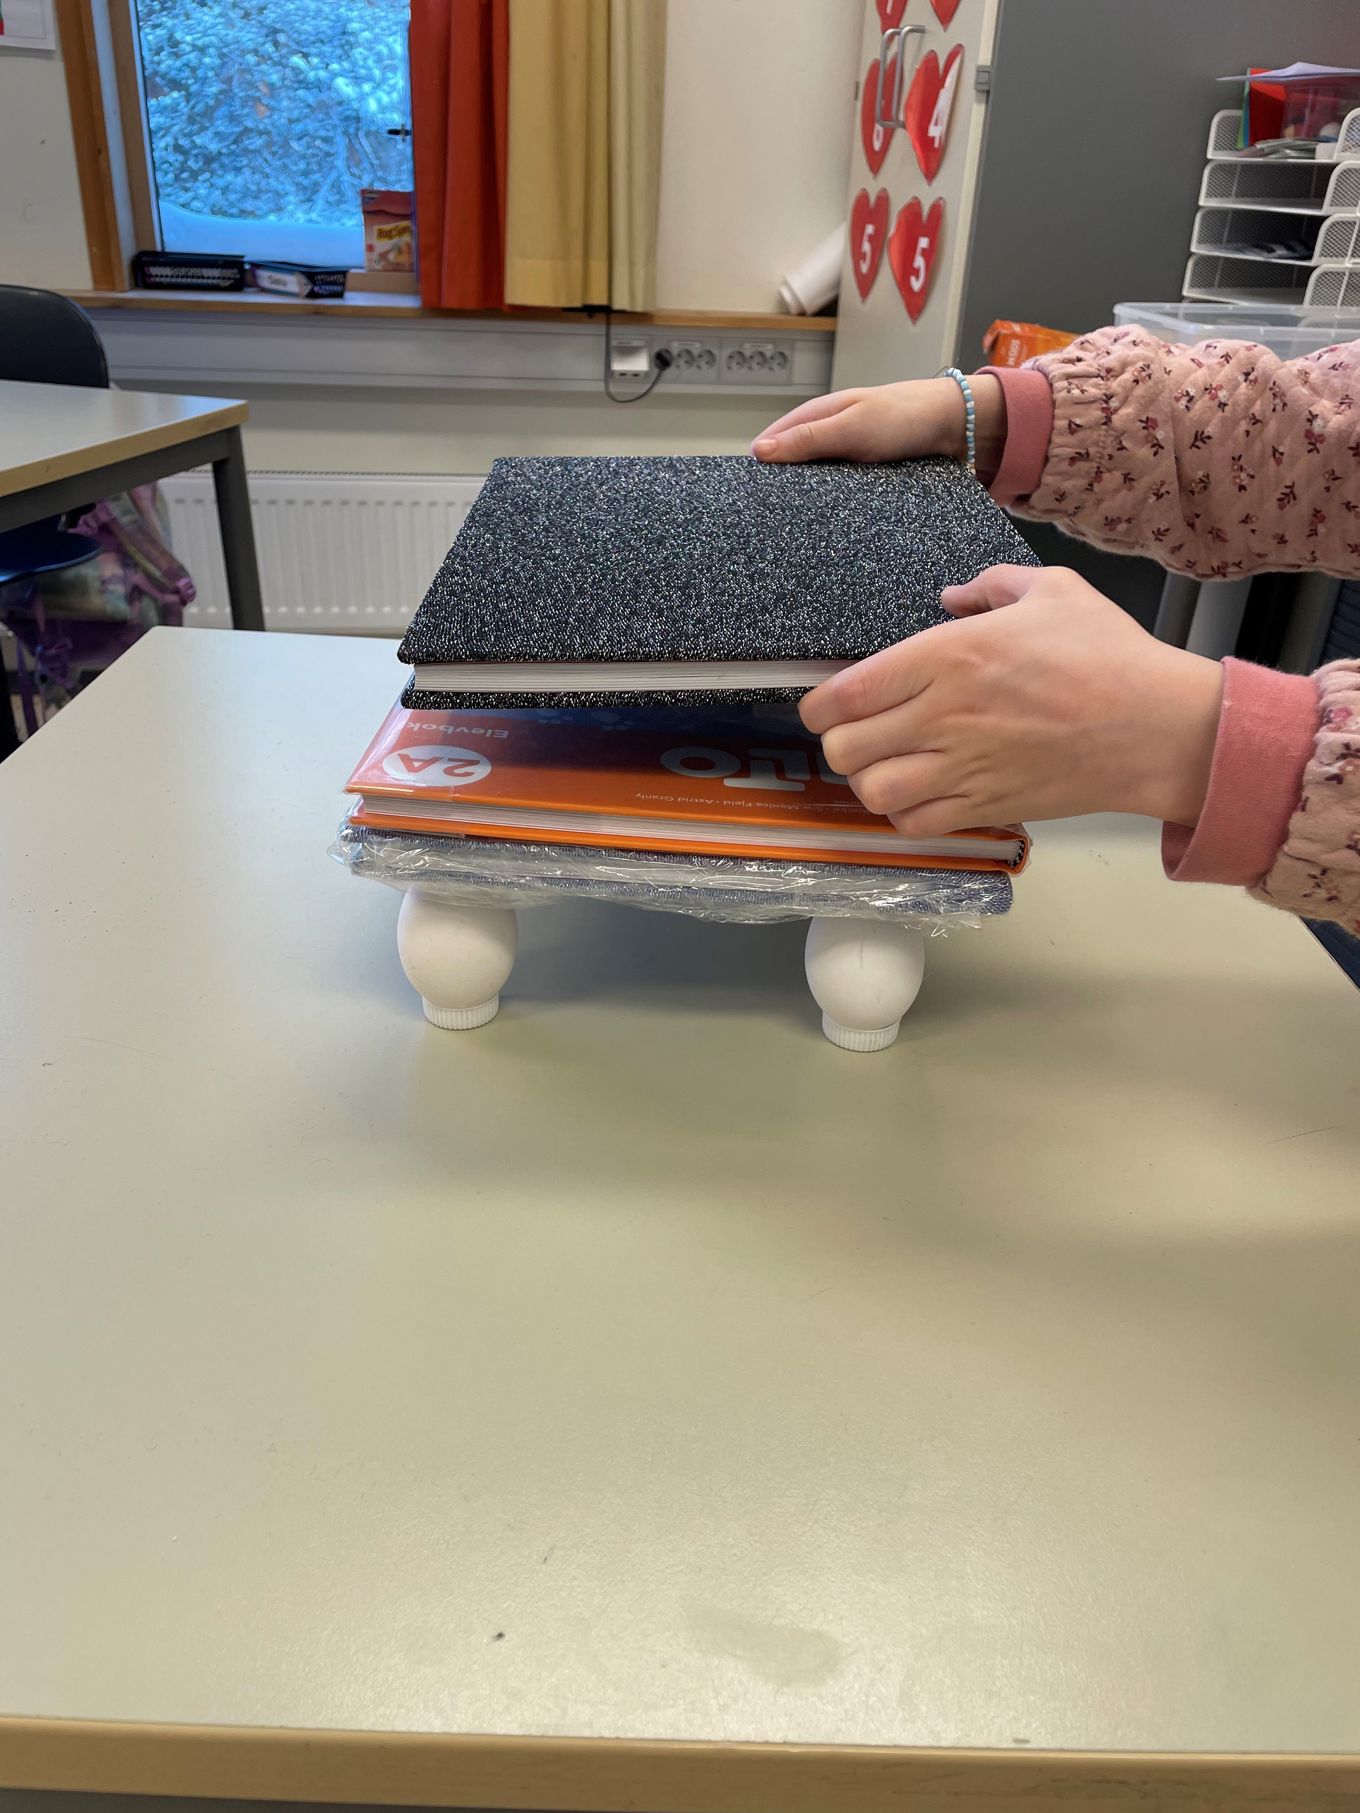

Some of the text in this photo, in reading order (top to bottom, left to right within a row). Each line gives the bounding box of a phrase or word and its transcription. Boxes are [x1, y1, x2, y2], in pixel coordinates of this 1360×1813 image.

[859, 224, 876, 274] 5
[909, 237, 930, 293] 5
[406, 721, 510, 739] Elevbok
[397, 753, 481, 778] 2A
[634, 792, 675, 801] Granly
[677, 796, 714, 805] Astrid
[723, 799, 753, 808] Fjeld
[756, 801, 800, 810] Monica
